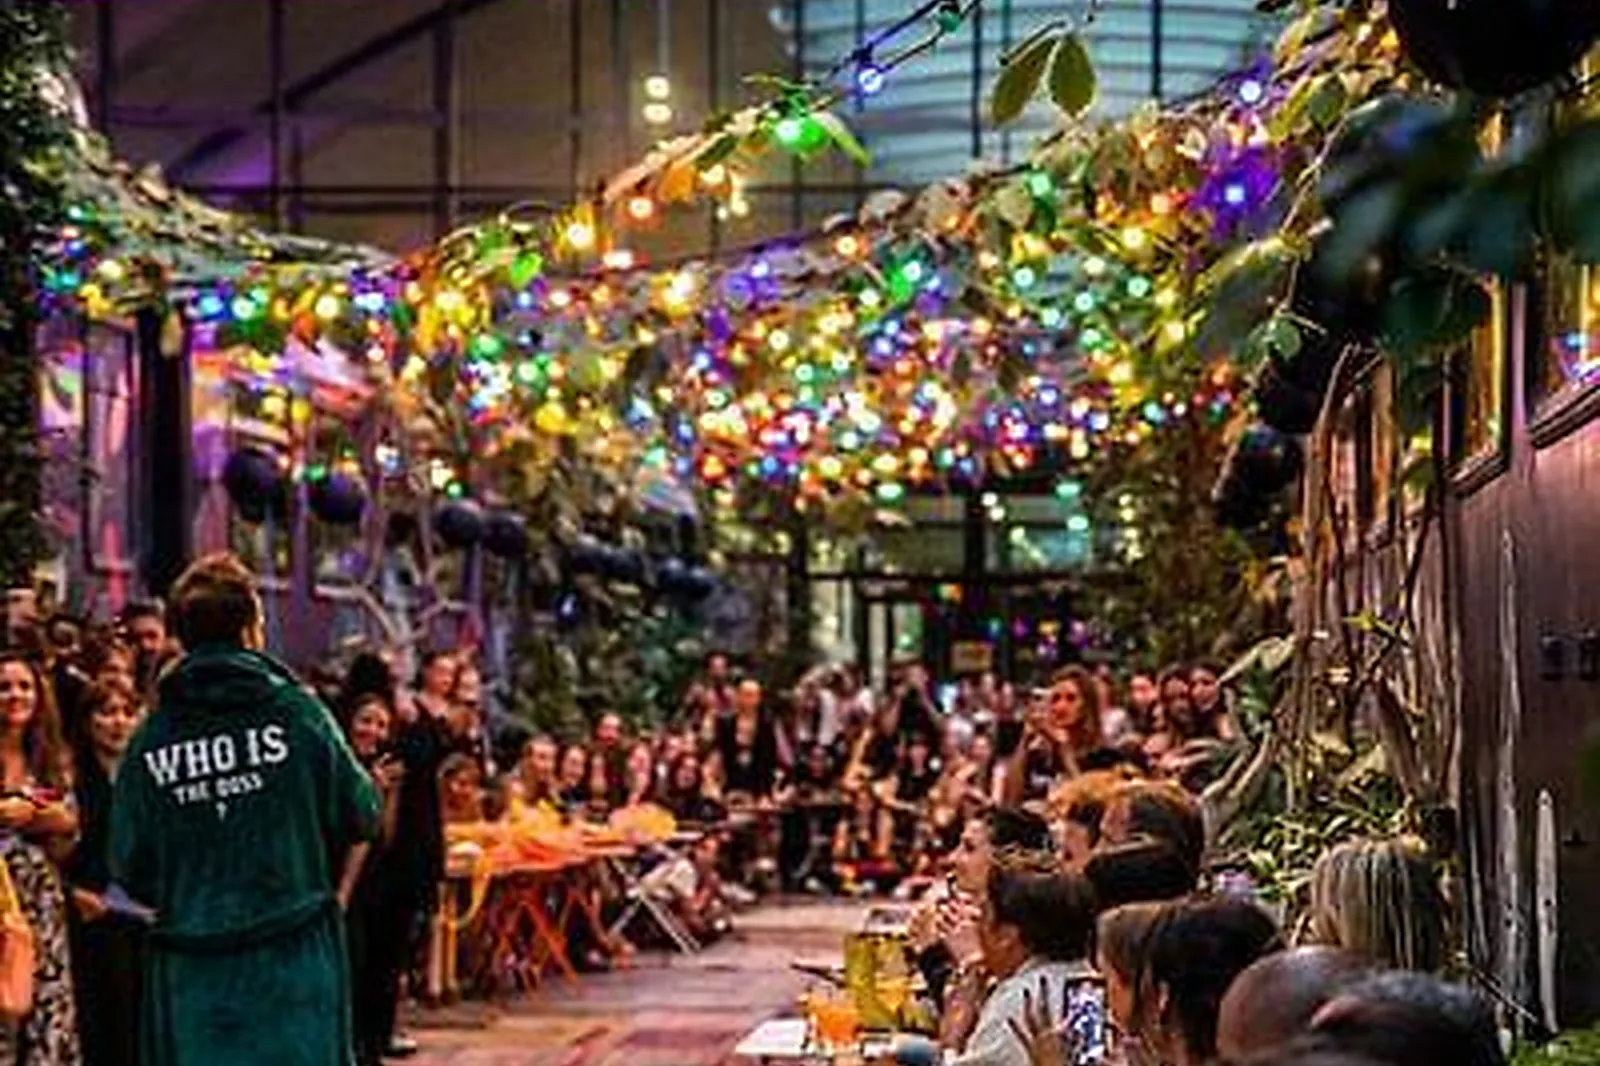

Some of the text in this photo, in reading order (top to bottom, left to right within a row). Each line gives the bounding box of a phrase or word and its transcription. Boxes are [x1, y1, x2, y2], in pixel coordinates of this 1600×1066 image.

[143, 723, 289, 786] WHO IS
[171, 780, 211, 805] THE
